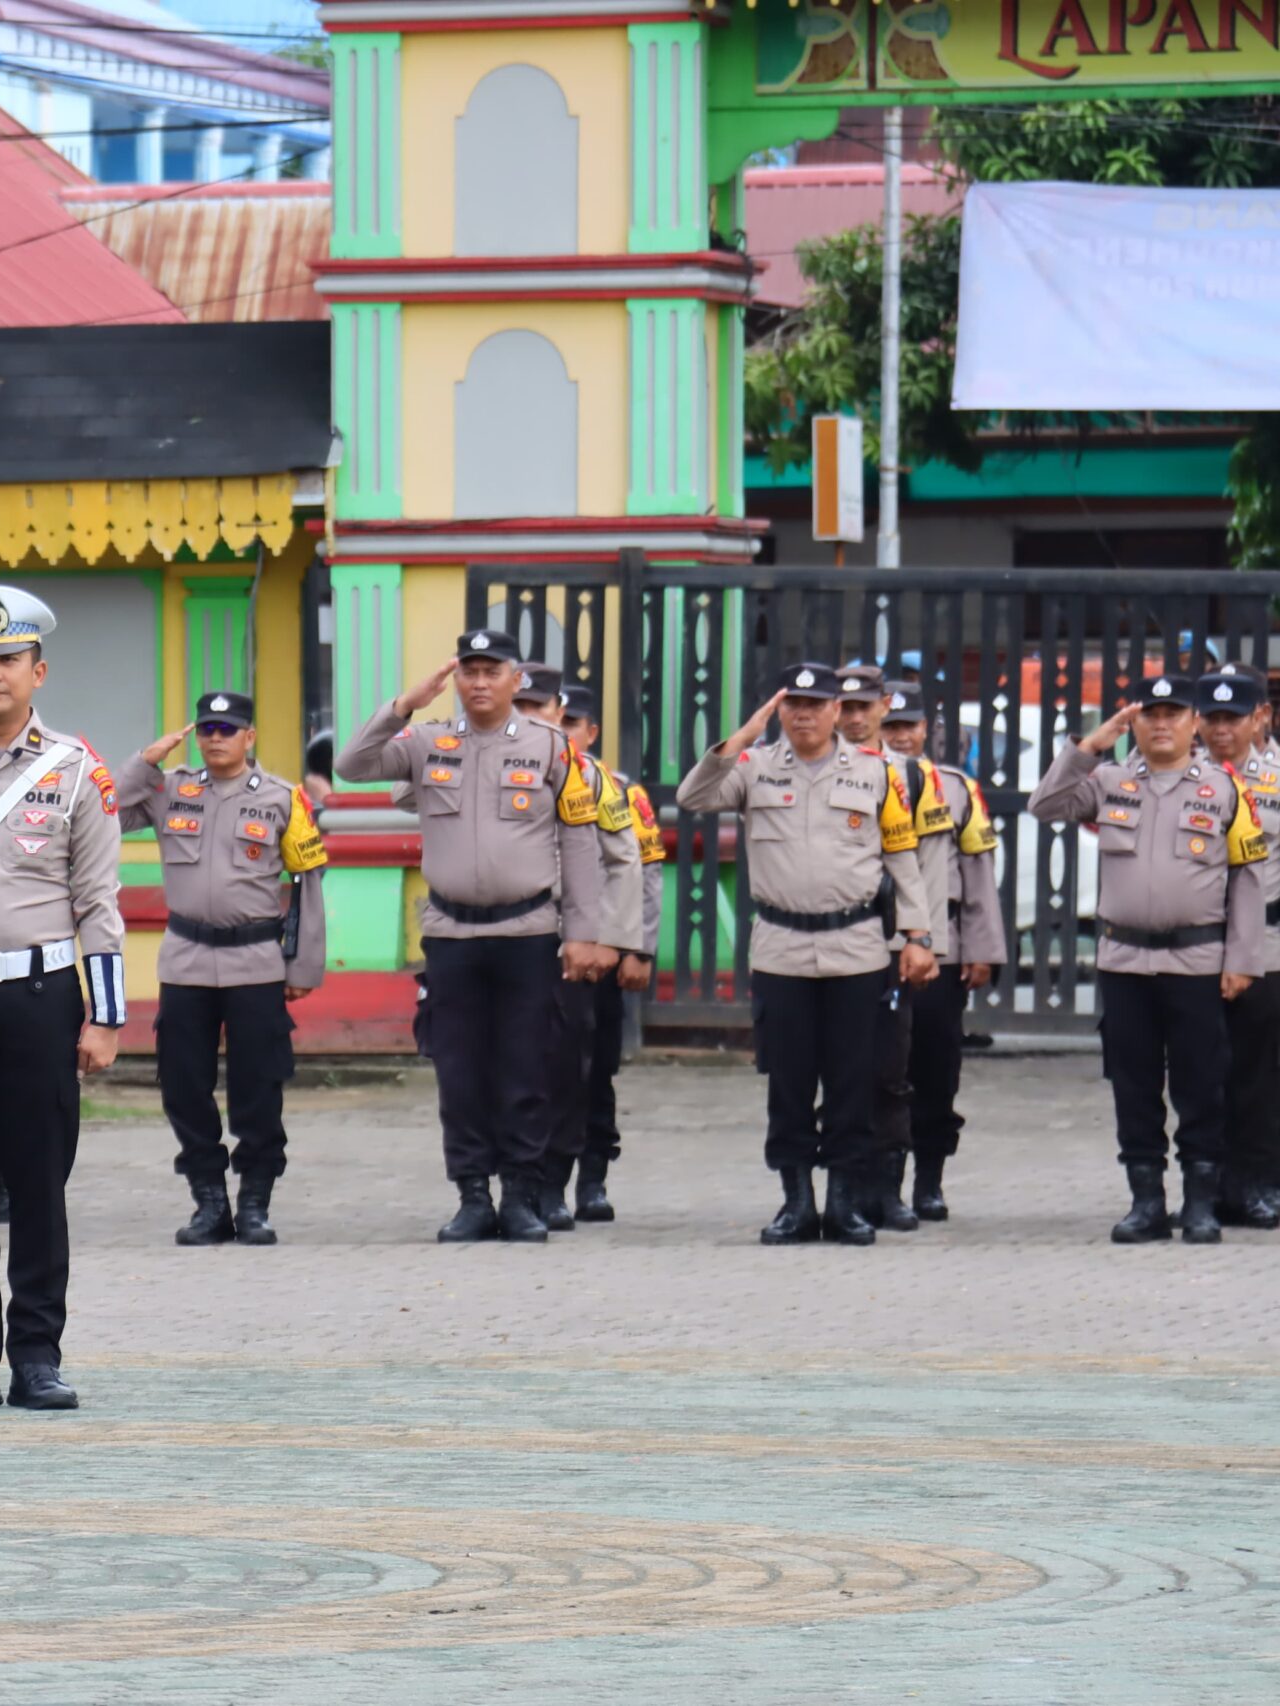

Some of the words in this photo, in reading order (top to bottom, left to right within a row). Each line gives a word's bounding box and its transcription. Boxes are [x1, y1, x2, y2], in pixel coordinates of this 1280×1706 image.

[503, 758, 540, 769] POLRI
[836, 778, 873, 792] POLRI
[24, 791, 61, 805] OLRI
[240, 807, 276, 822] POLRI
[1183, 800, 1221, 815] POLRI
